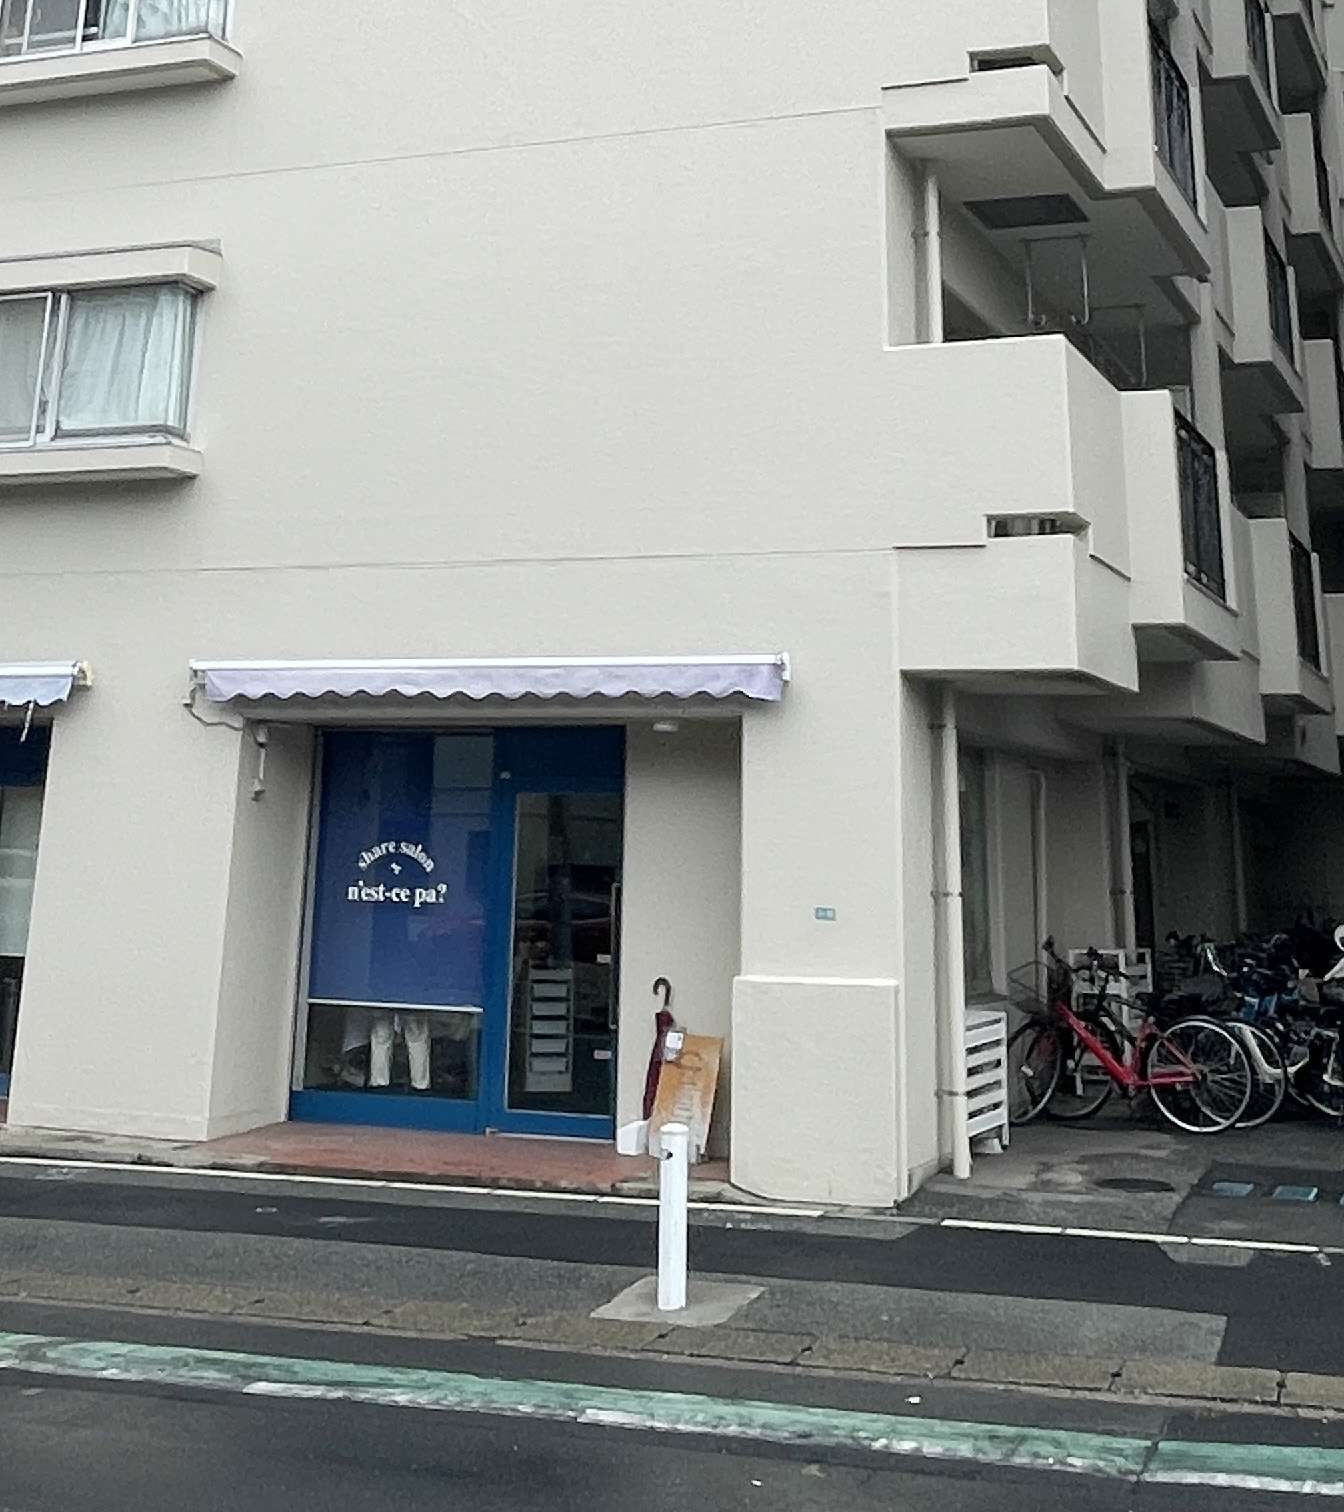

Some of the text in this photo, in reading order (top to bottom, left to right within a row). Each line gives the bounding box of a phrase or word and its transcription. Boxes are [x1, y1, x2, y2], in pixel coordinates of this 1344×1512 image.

[358, 841, 435, 873] share salon
[347, 880, 448, 908] n'est-ce pa?
